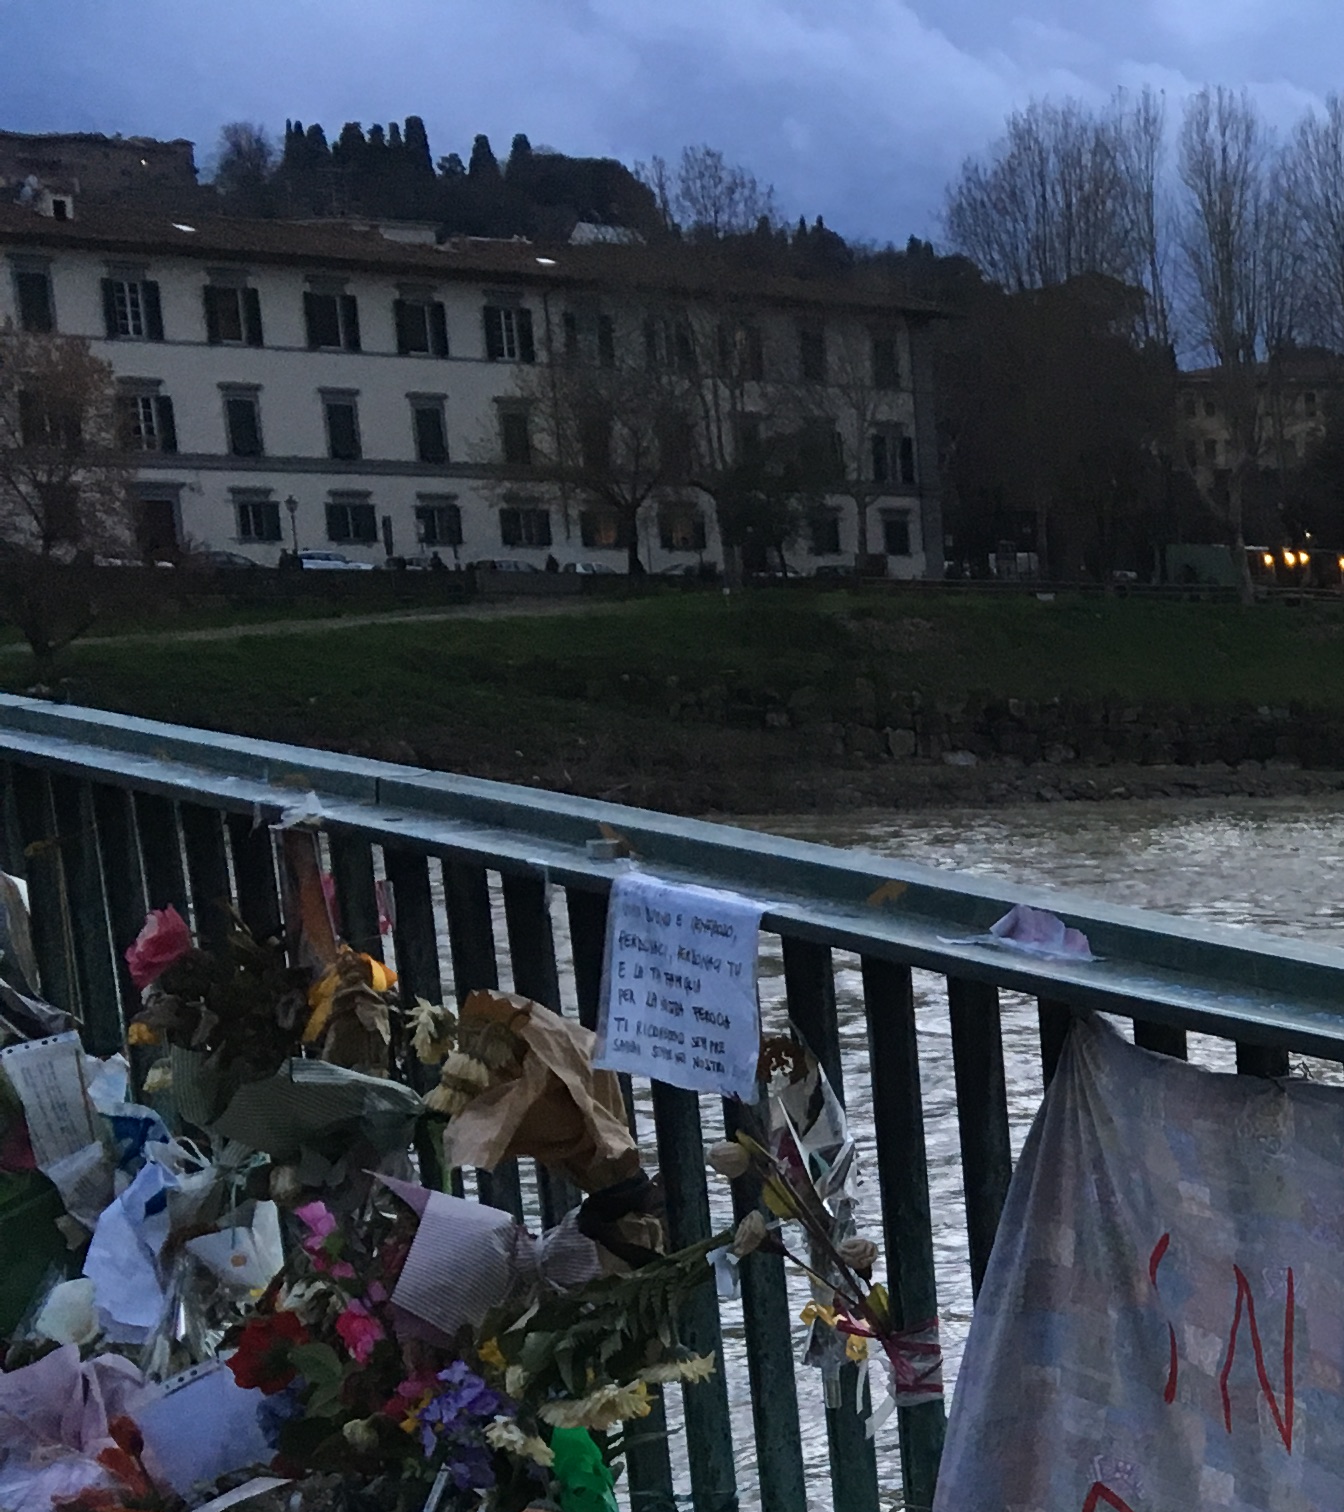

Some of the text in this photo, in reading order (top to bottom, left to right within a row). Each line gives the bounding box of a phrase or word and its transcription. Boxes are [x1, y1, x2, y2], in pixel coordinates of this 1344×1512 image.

[618, 988, 636, 1006] PER
[613, 1016, 629, 1033] TI
[1148, 1231, 1297, 1457] IN
